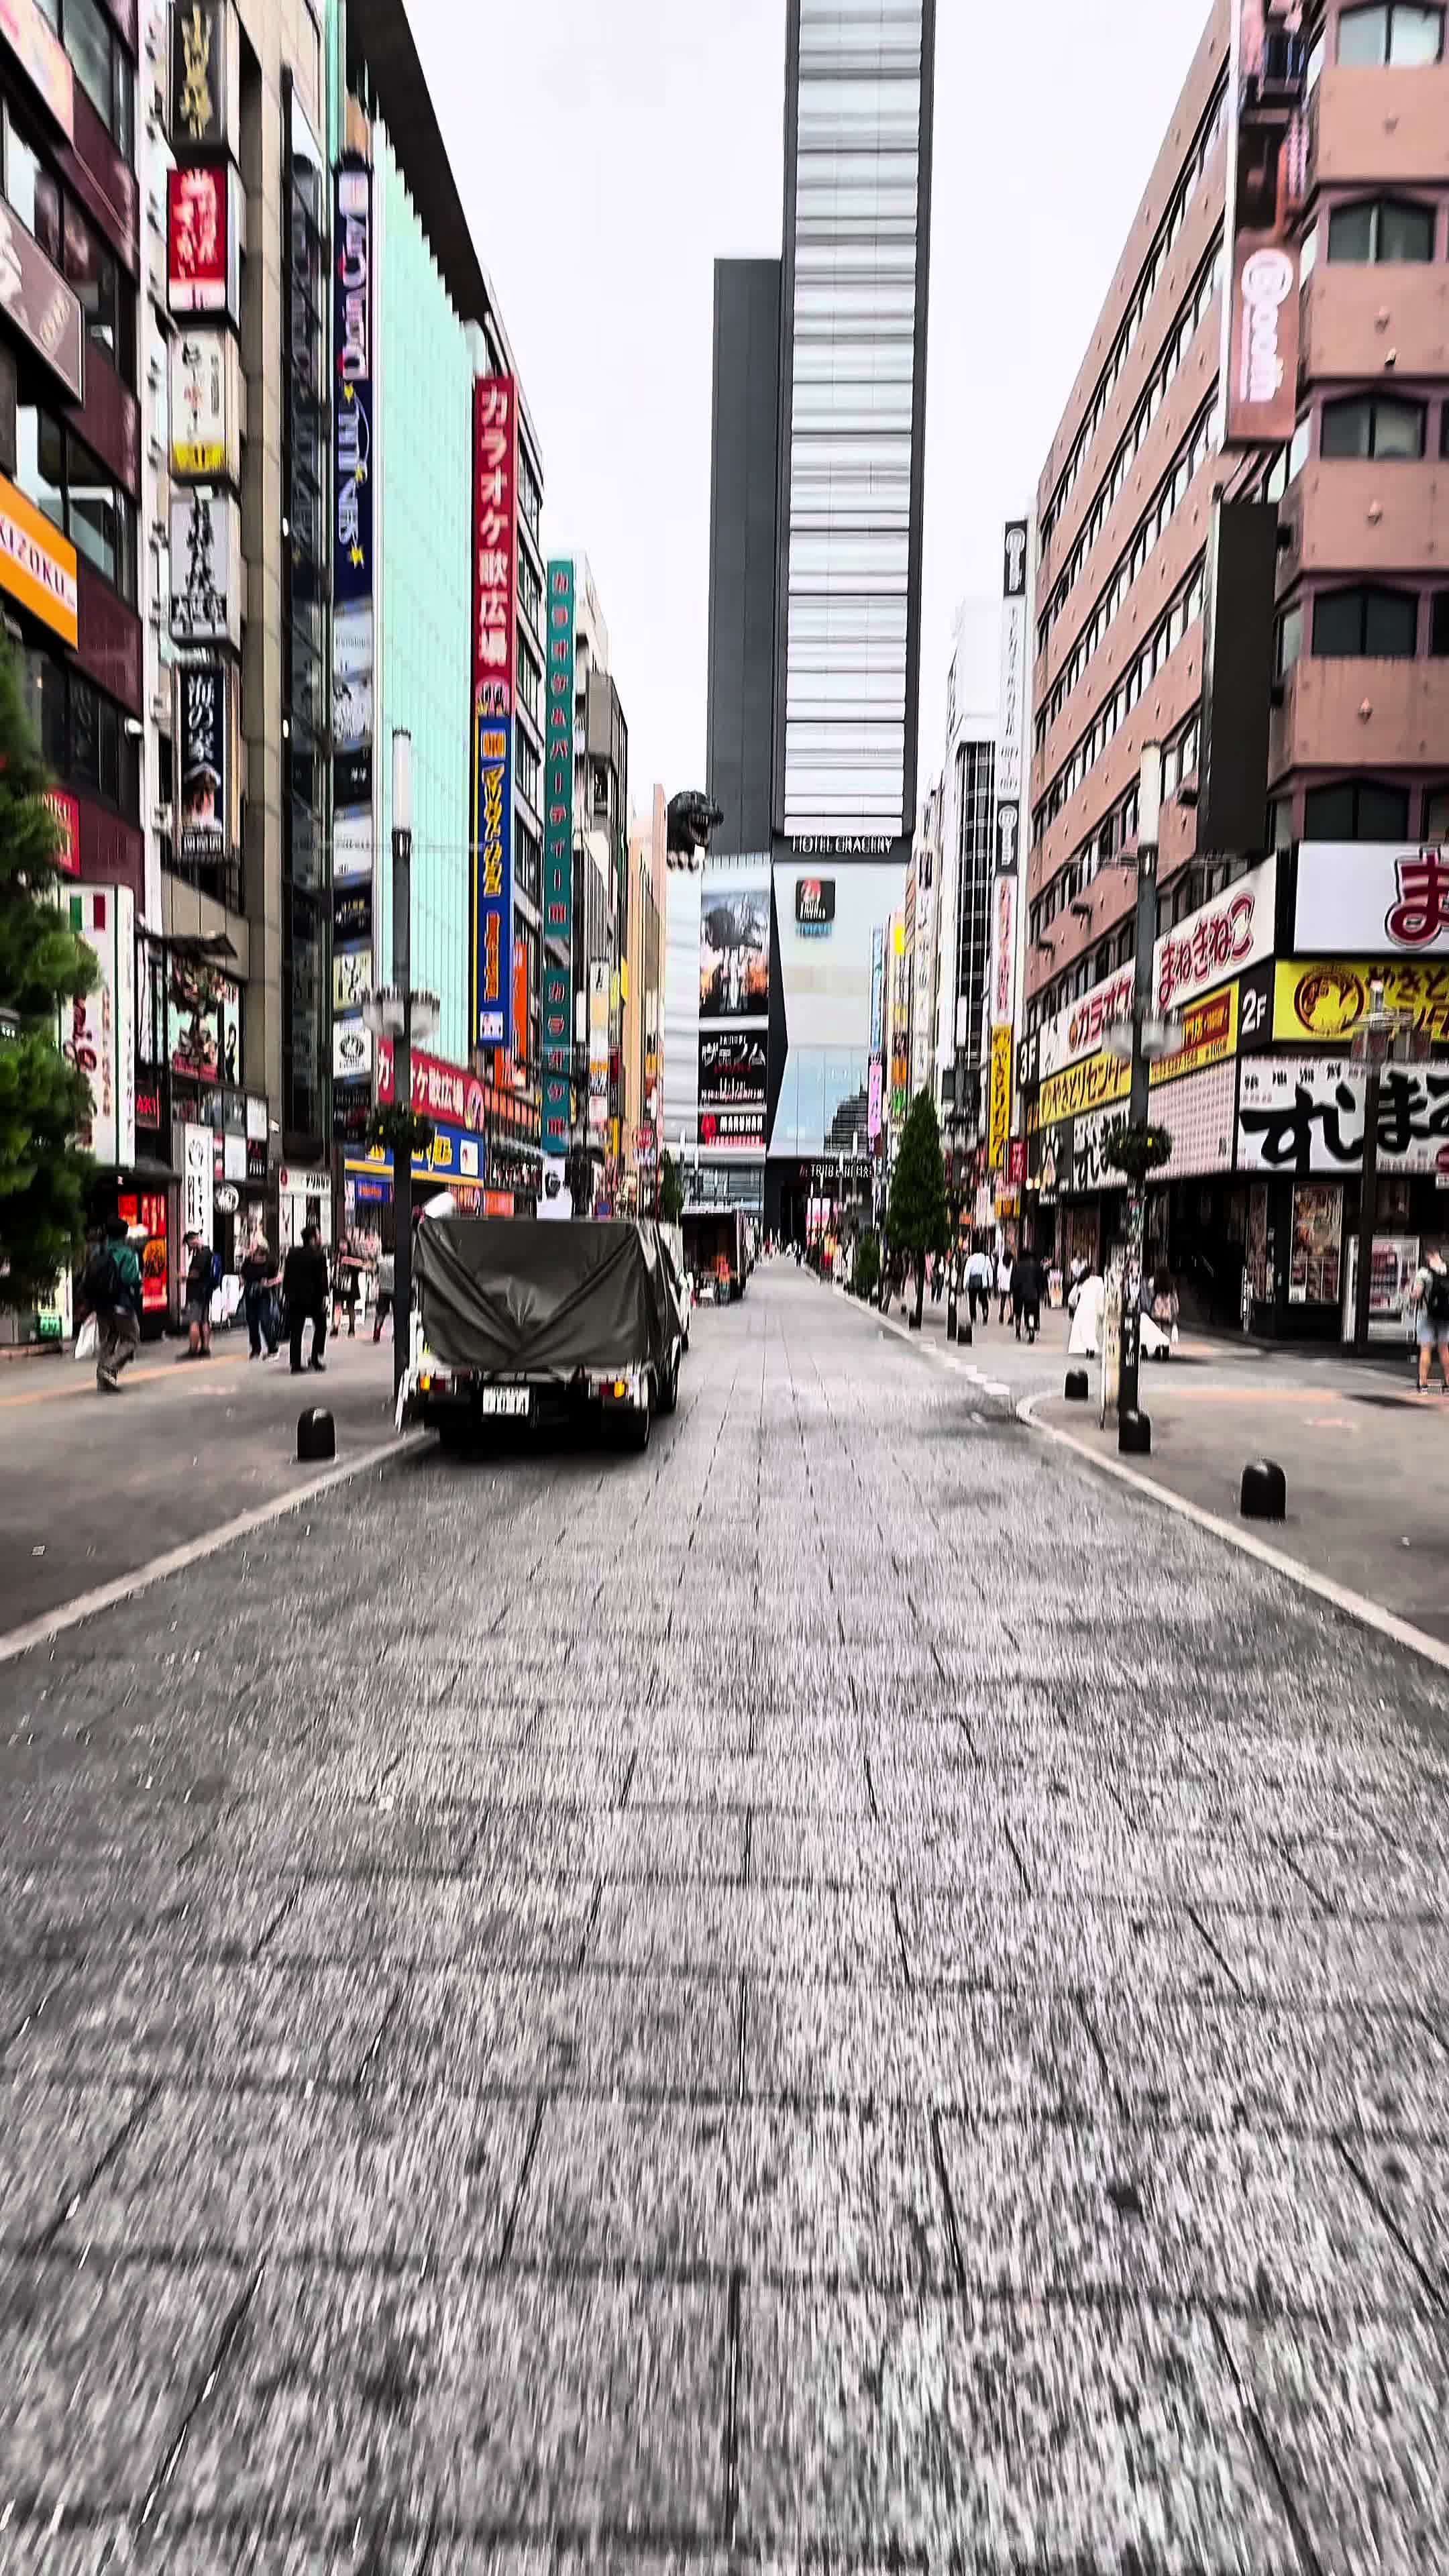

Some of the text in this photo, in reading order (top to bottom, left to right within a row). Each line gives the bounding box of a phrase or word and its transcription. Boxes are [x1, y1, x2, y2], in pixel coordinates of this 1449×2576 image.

[481, 385, 508, 667] カラオケ歌広場
[1159, 892, 1255, 1006] まねきねこ
[1241, 988, 1267, 1037] 2F
[1019, 1038, 1037, 1085] 3F
